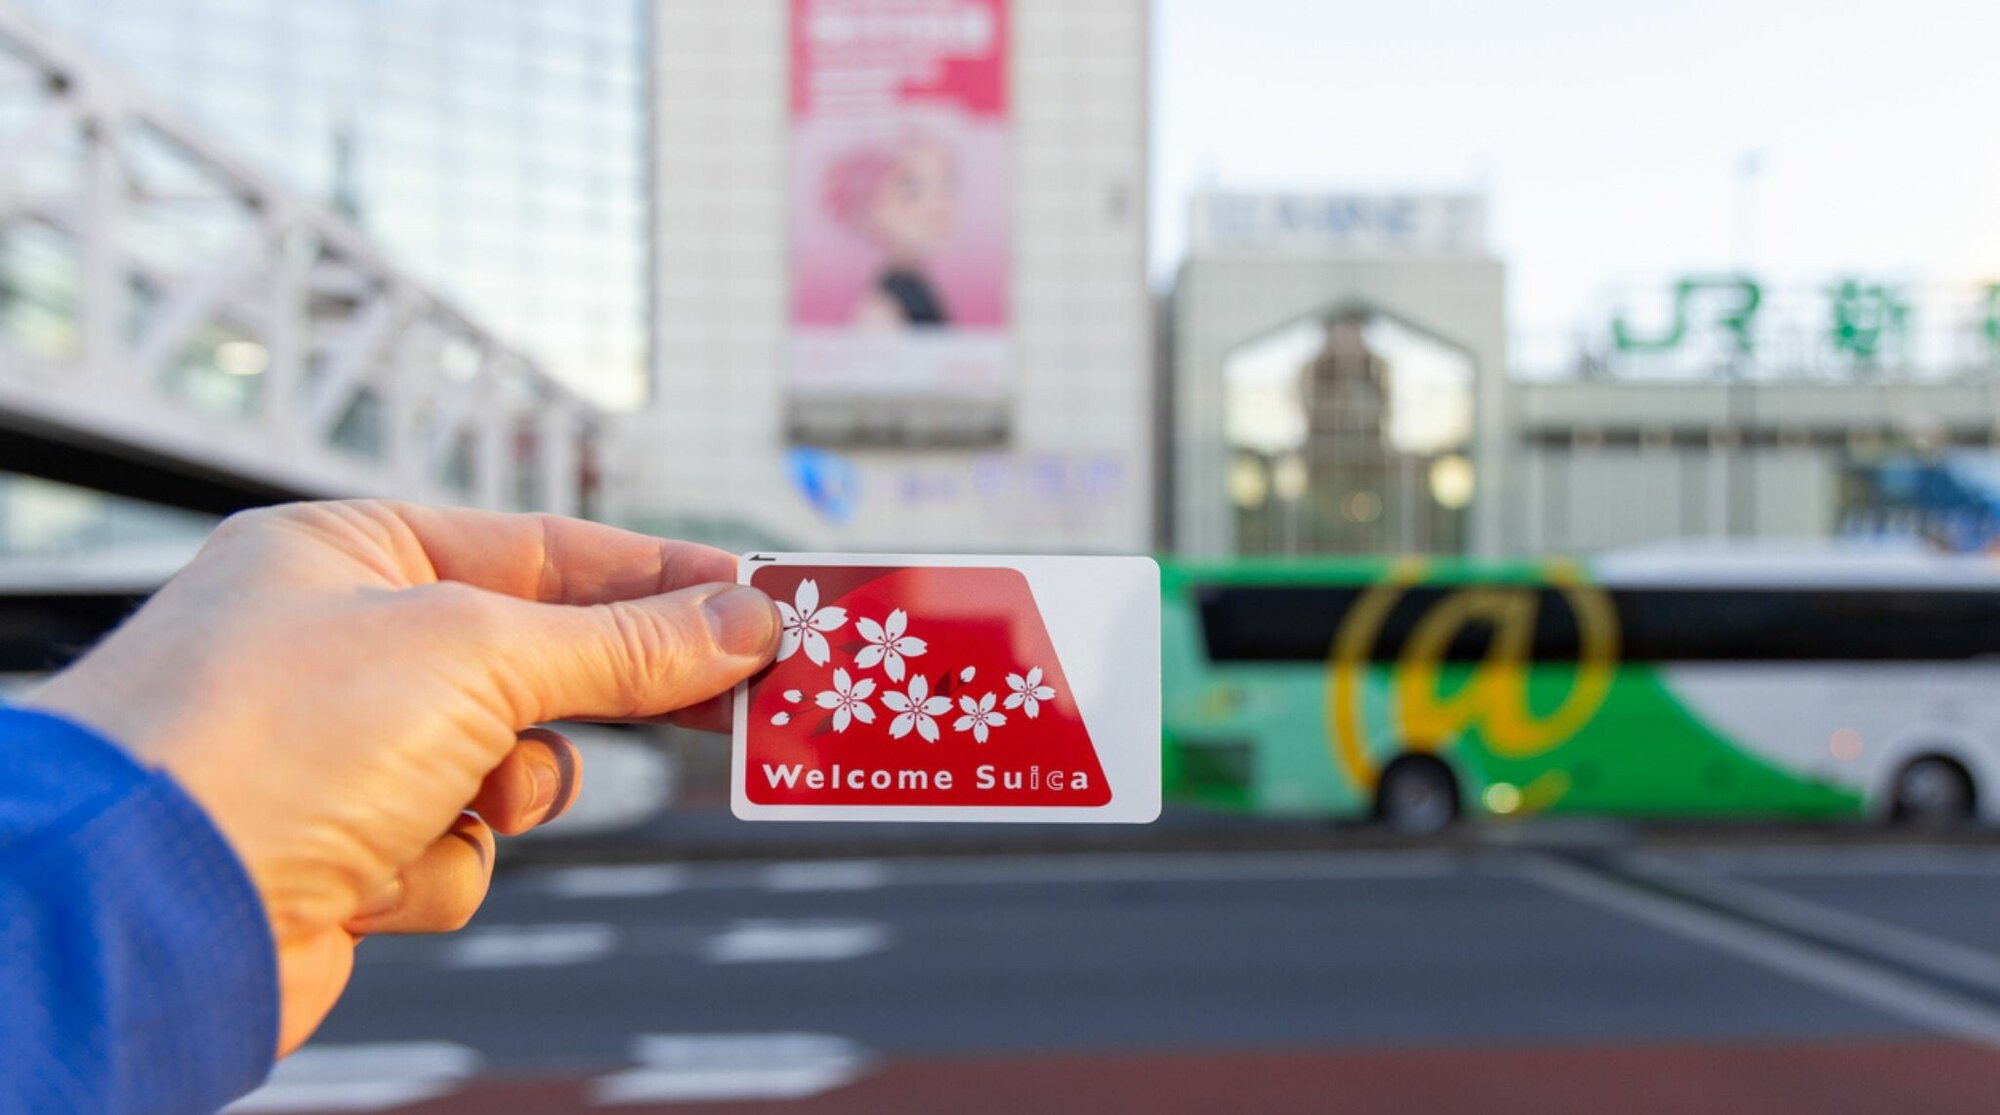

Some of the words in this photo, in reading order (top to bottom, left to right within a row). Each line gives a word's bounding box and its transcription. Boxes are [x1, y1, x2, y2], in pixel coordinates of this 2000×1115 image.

[1612, 274, 1763, 354] JR
[762, 763, 954, 790] Welcome
[976, 765, 1090, 791] Suica
